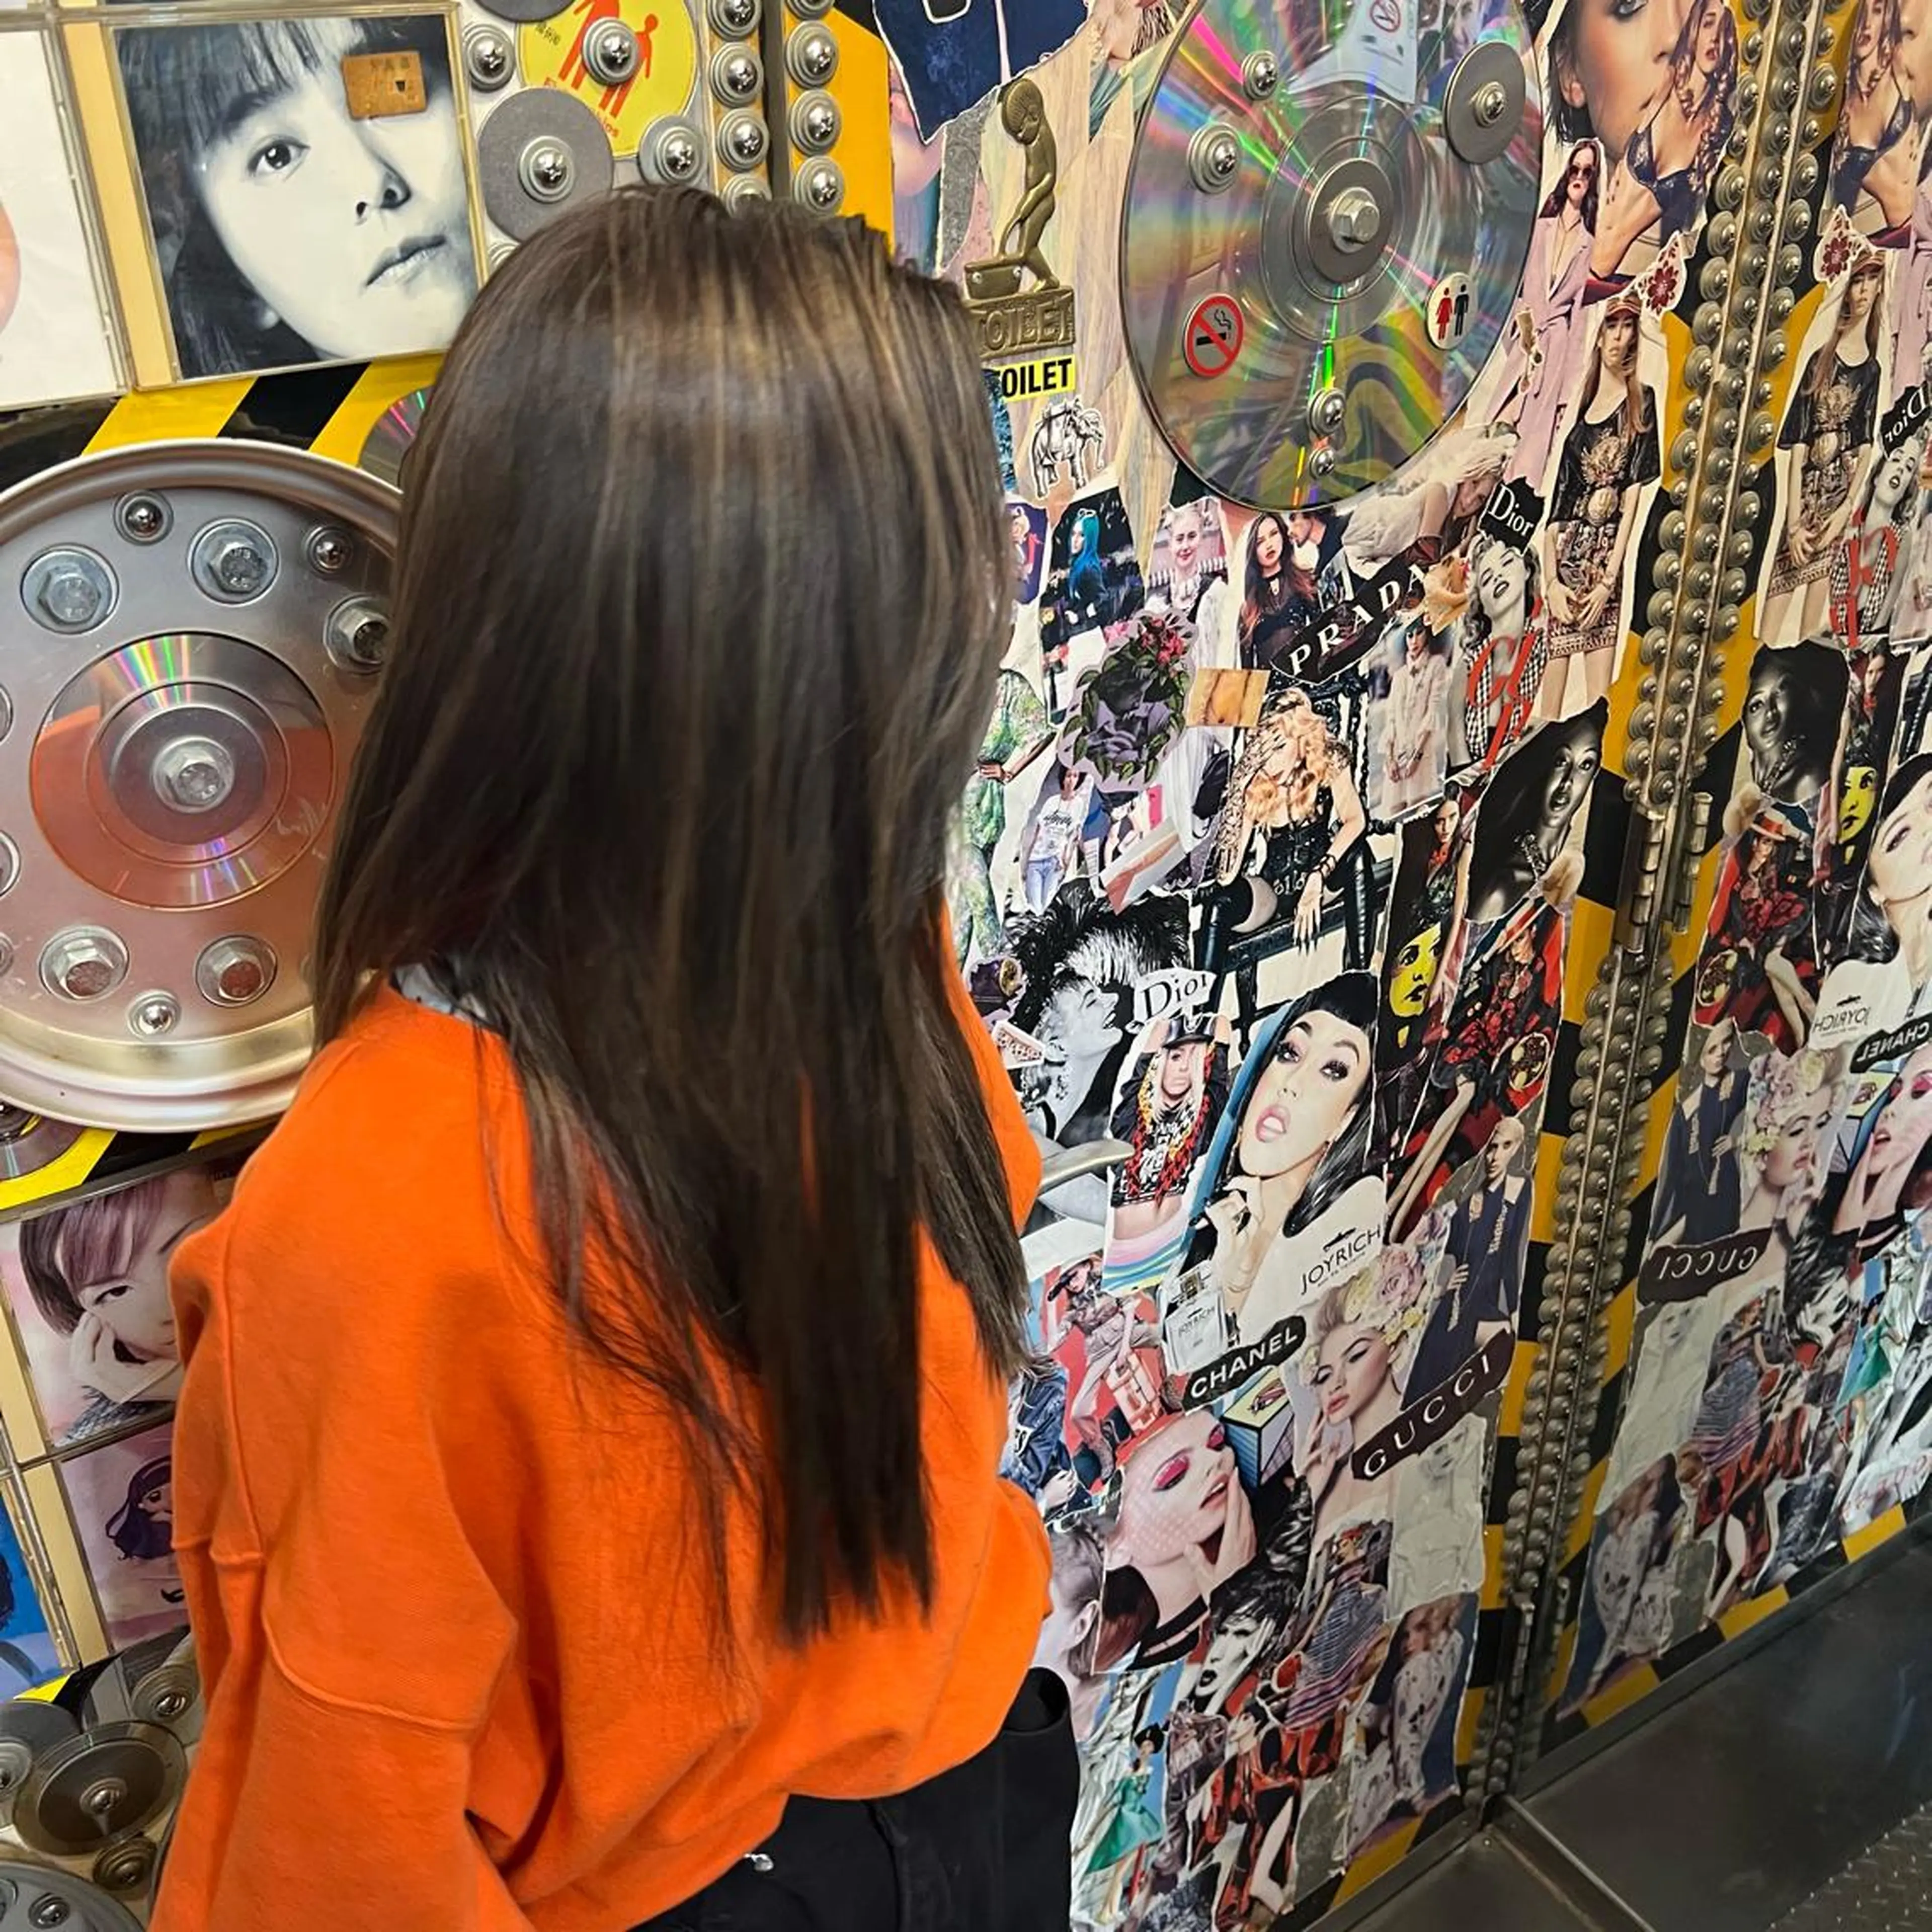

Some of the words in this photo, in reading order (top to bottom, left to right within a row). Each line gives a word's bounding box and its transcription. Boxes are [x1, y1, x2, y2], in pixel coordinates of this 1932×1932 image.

[995, 358, 1072, 397] OILET
[1488, 484, 1535, 536] Dior
[1289, 563, 1425, 676] PRADA
[1301, 1224, 1381, 1296] JOYRICH
[1190, 1327, 1297, 1398] CHANEL
[1364, 1353, 1489, 1477] GUCCI
